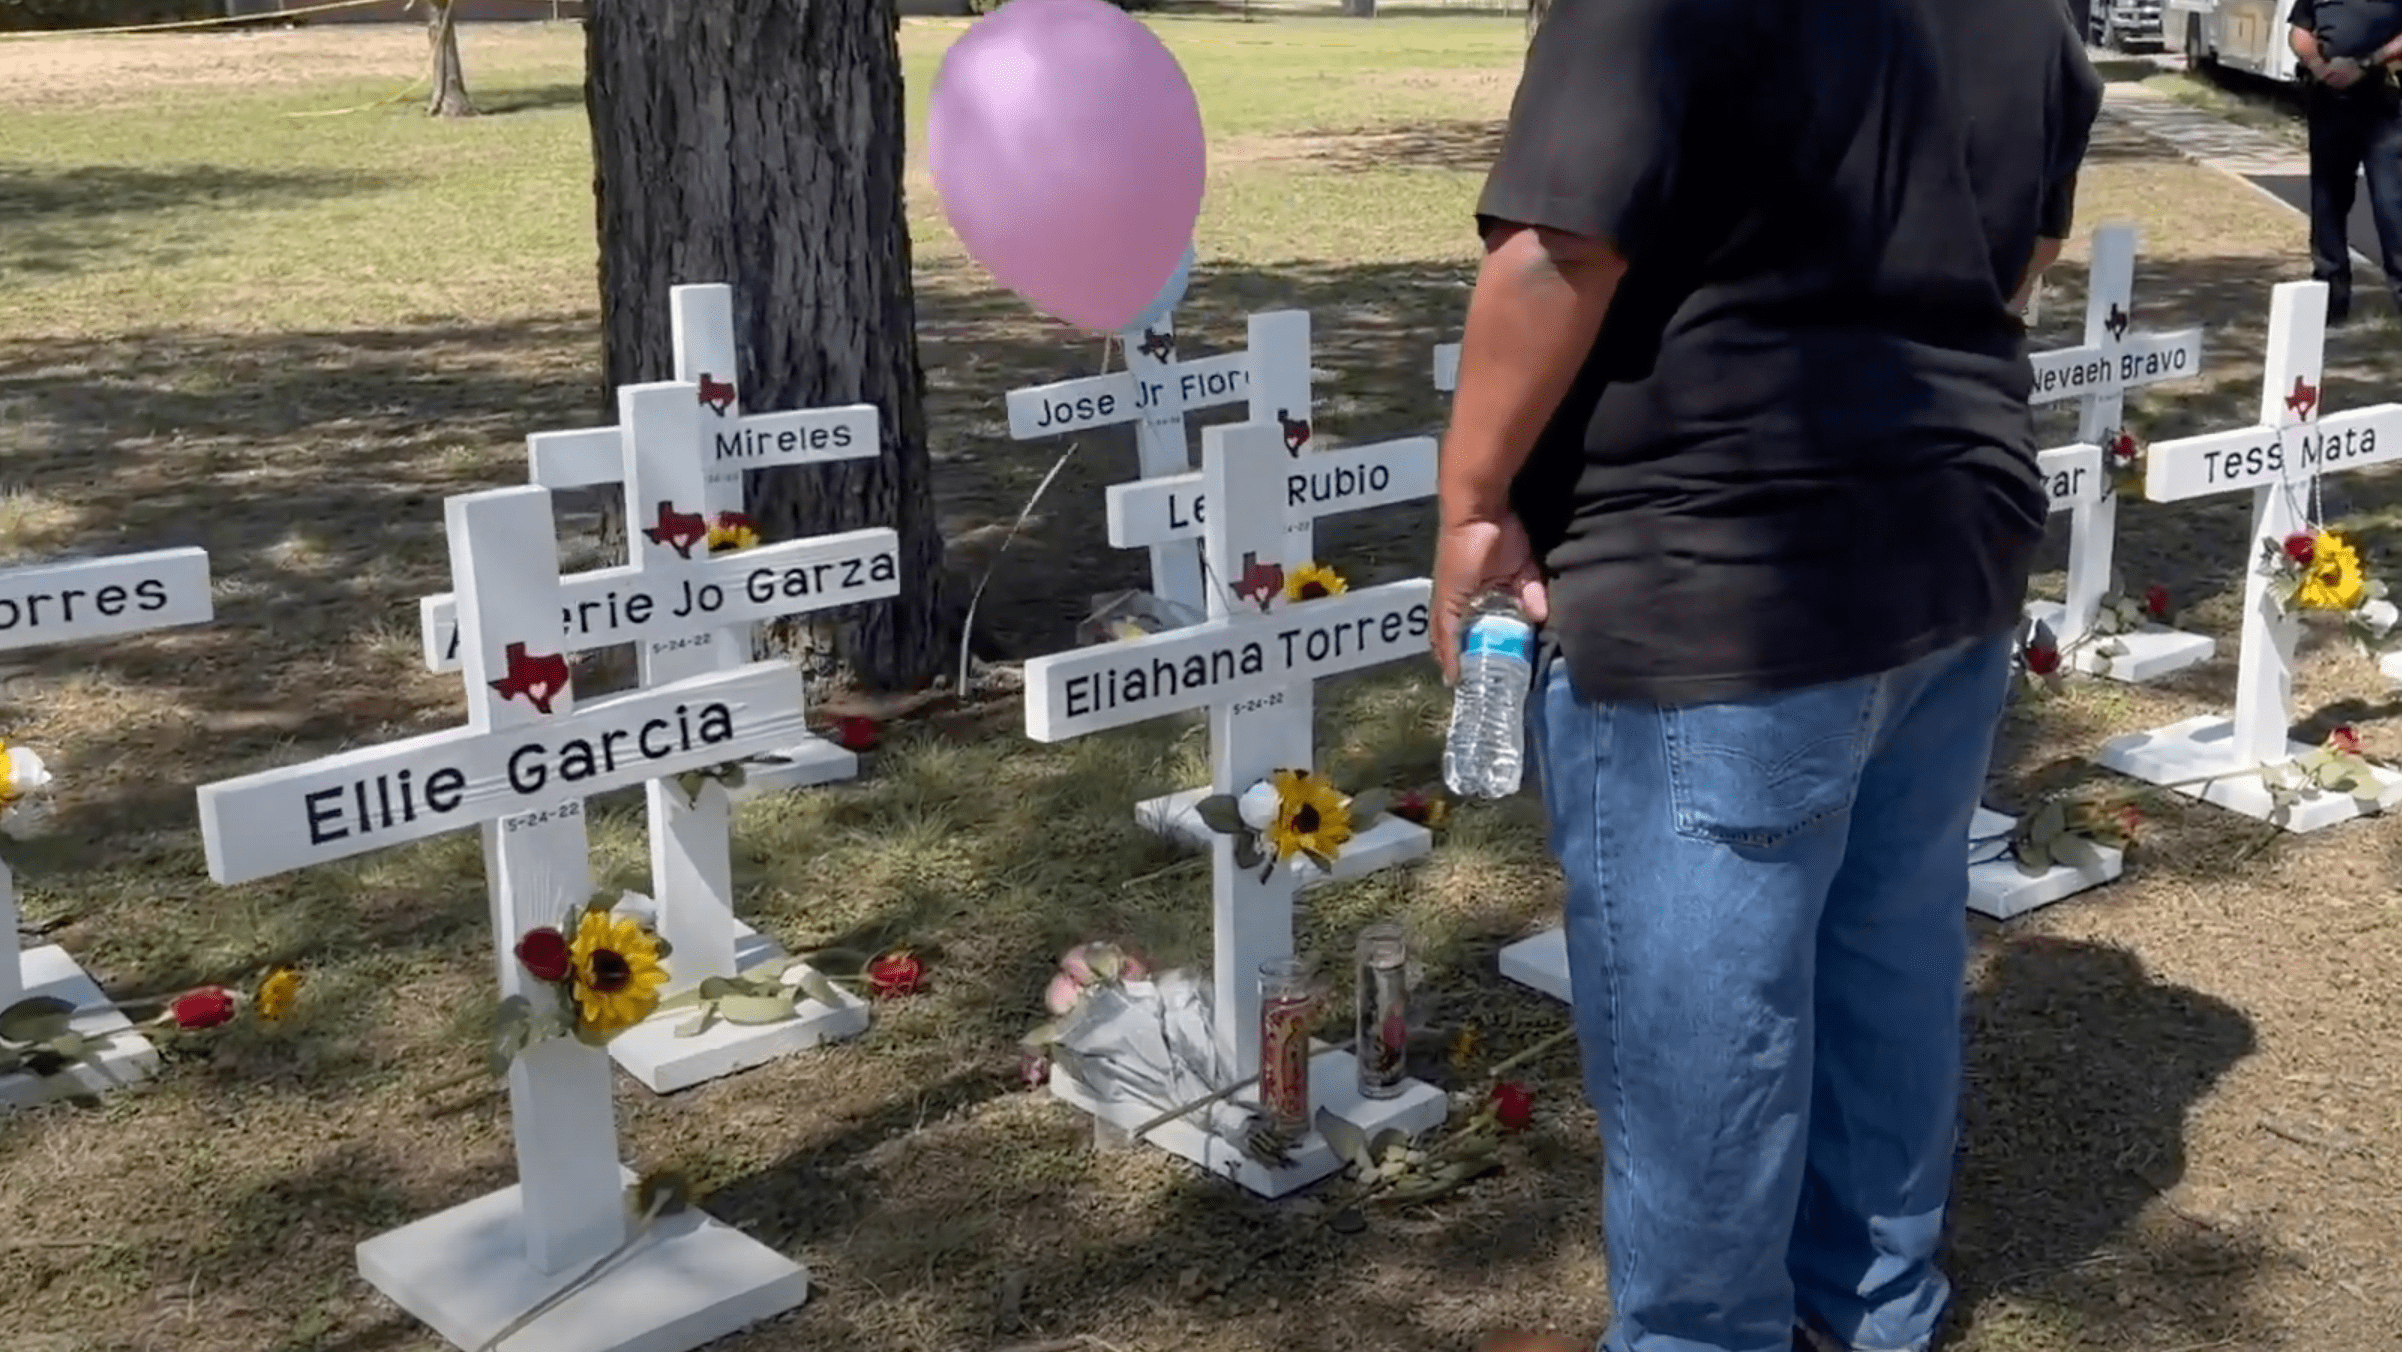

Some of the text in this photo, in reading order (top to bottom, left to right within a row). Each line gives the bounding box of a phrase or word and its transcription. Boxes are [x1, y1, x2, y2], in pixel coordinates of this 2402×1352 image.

[2121, 348, 2186, 380] Bravo
[1037, 370, 1249, 427] Jose Jr Flor
[716, 424, 852, 460] Mireles
[2204, 427, 2375, 483] Tess Mata
[1169, 464, 1390, 529] Le Rubio
[672, 579, 724, 617] Jo
[746, 552, 895, 603] Garza
[652, 633, 711, 654] 5-24-22
[1065, 603, 1429, 718] Eliahana Torres
[1233, 692, 1284, 715] 5-24-22
[305, 702, 734, 846] Ellie Garcia
[507, 802, 580, 832] 5-24-22
